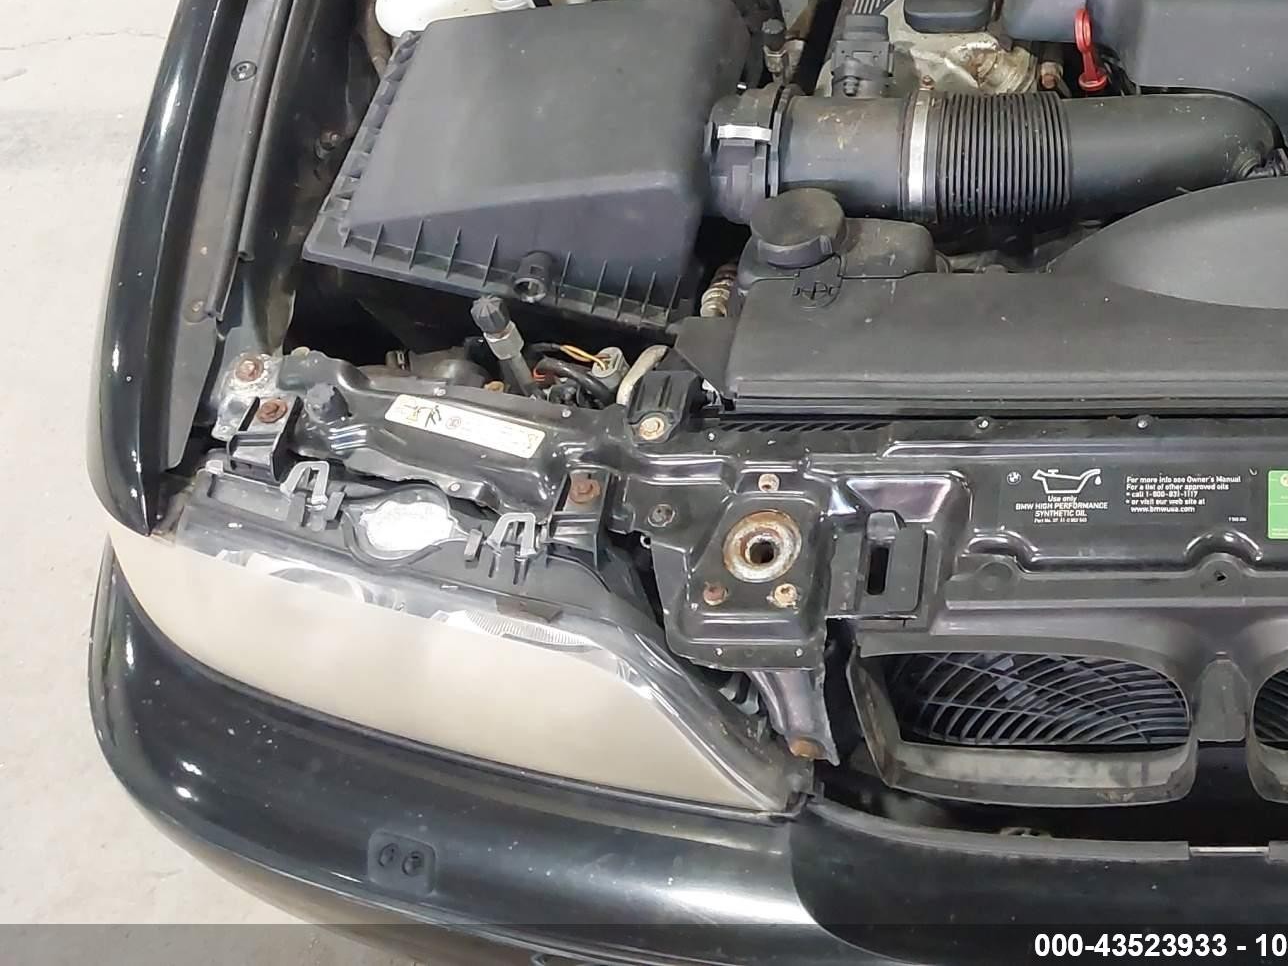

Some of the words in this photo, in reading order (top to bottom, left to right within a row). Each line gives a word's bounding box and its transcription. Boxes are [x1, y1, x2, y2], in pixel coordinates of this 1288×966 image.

[1126, 483, 1139, 491] For
[1145, 483, 1156, 491] list
[1157, 483, 1165, 491] of
[1165, 483, 1183, 491] other
[1184, 483, 1216, 491] approved
[1216, 483, 1229, 491] oils
[1062, 495, 1078, 504] only
